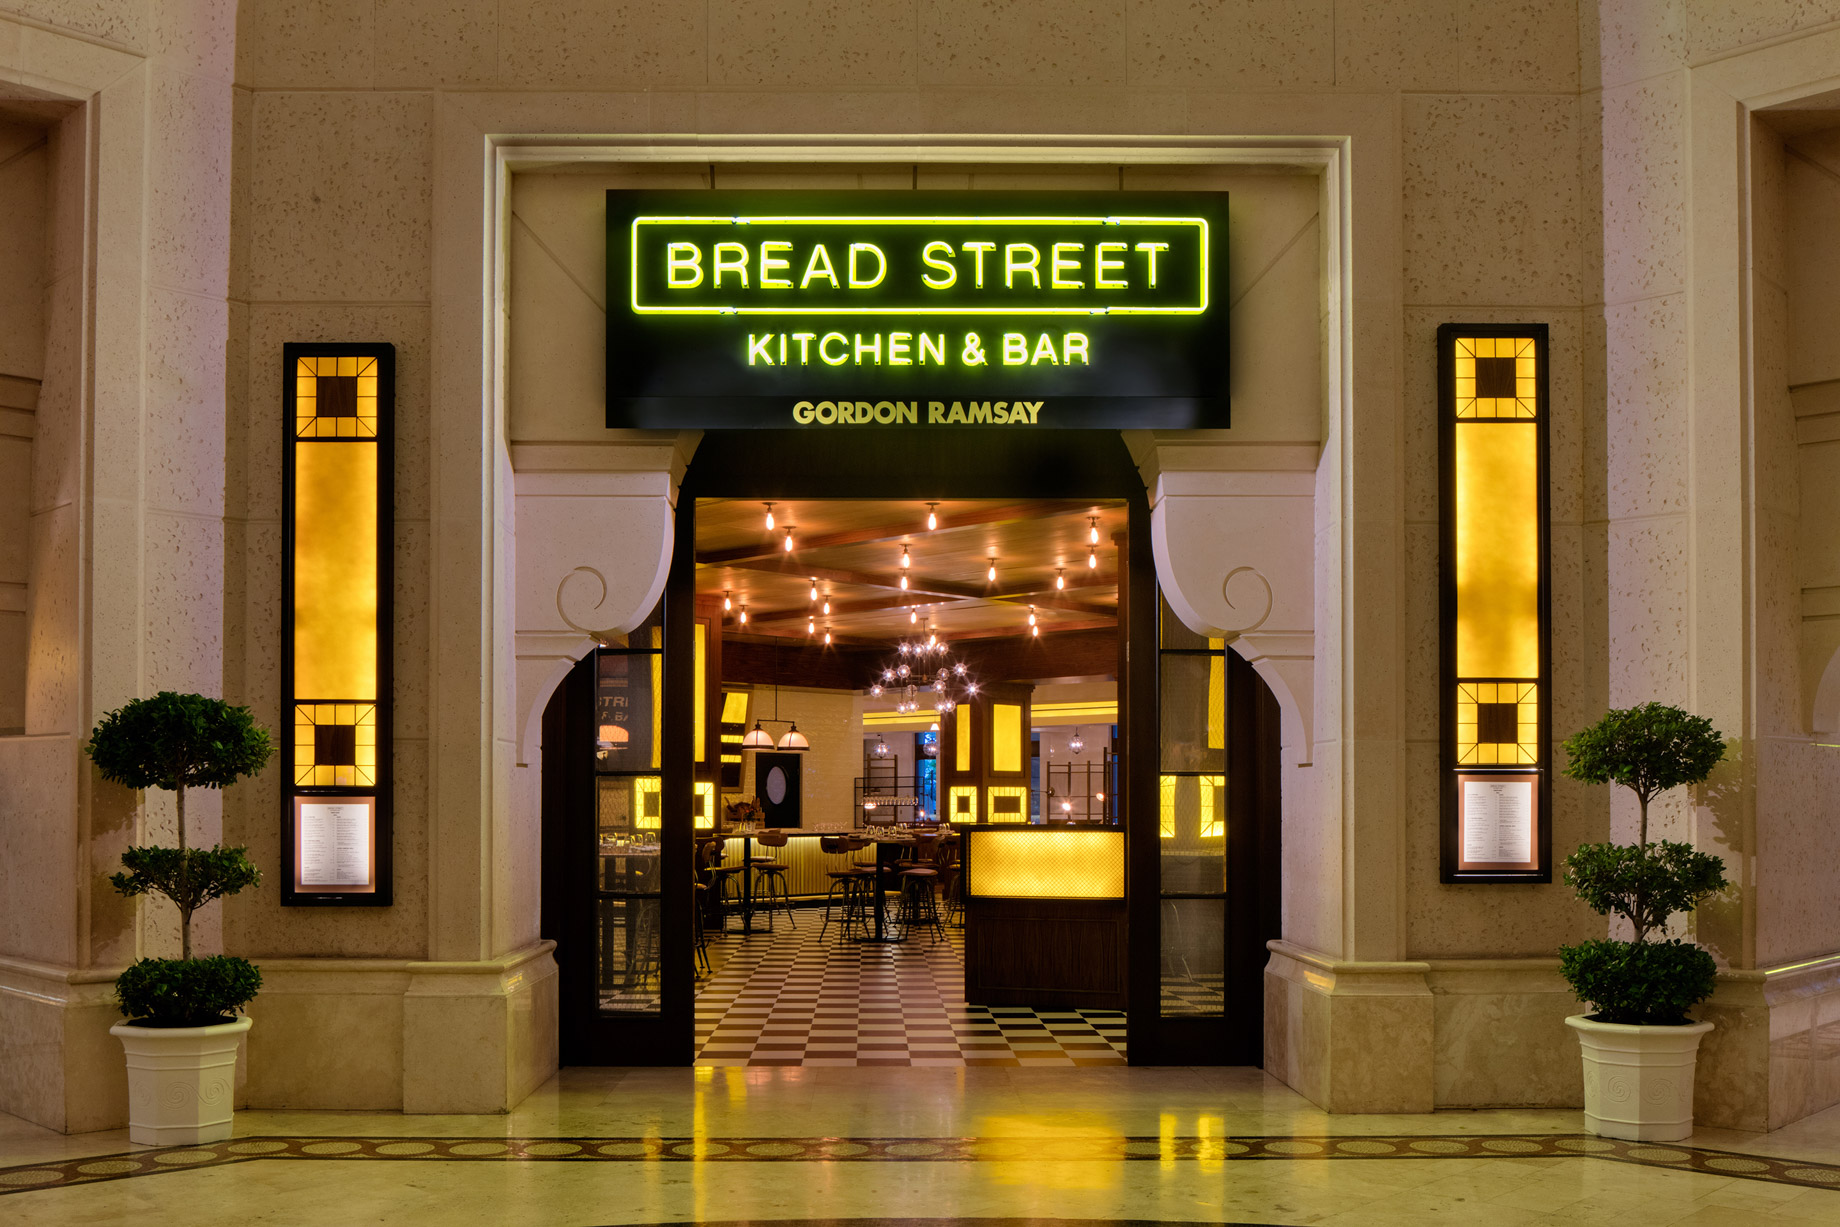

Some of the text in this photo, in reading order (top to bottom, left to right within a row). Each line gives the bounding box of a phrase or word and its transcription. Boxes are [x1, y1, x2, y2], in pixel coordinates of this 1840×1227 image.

[667, 241, 1170, 289] BREAD STREET
[748, 332, 1089, 366] KITCHEN & BAR
[793, 401, 1044, 424] GORDON RAMSAY
